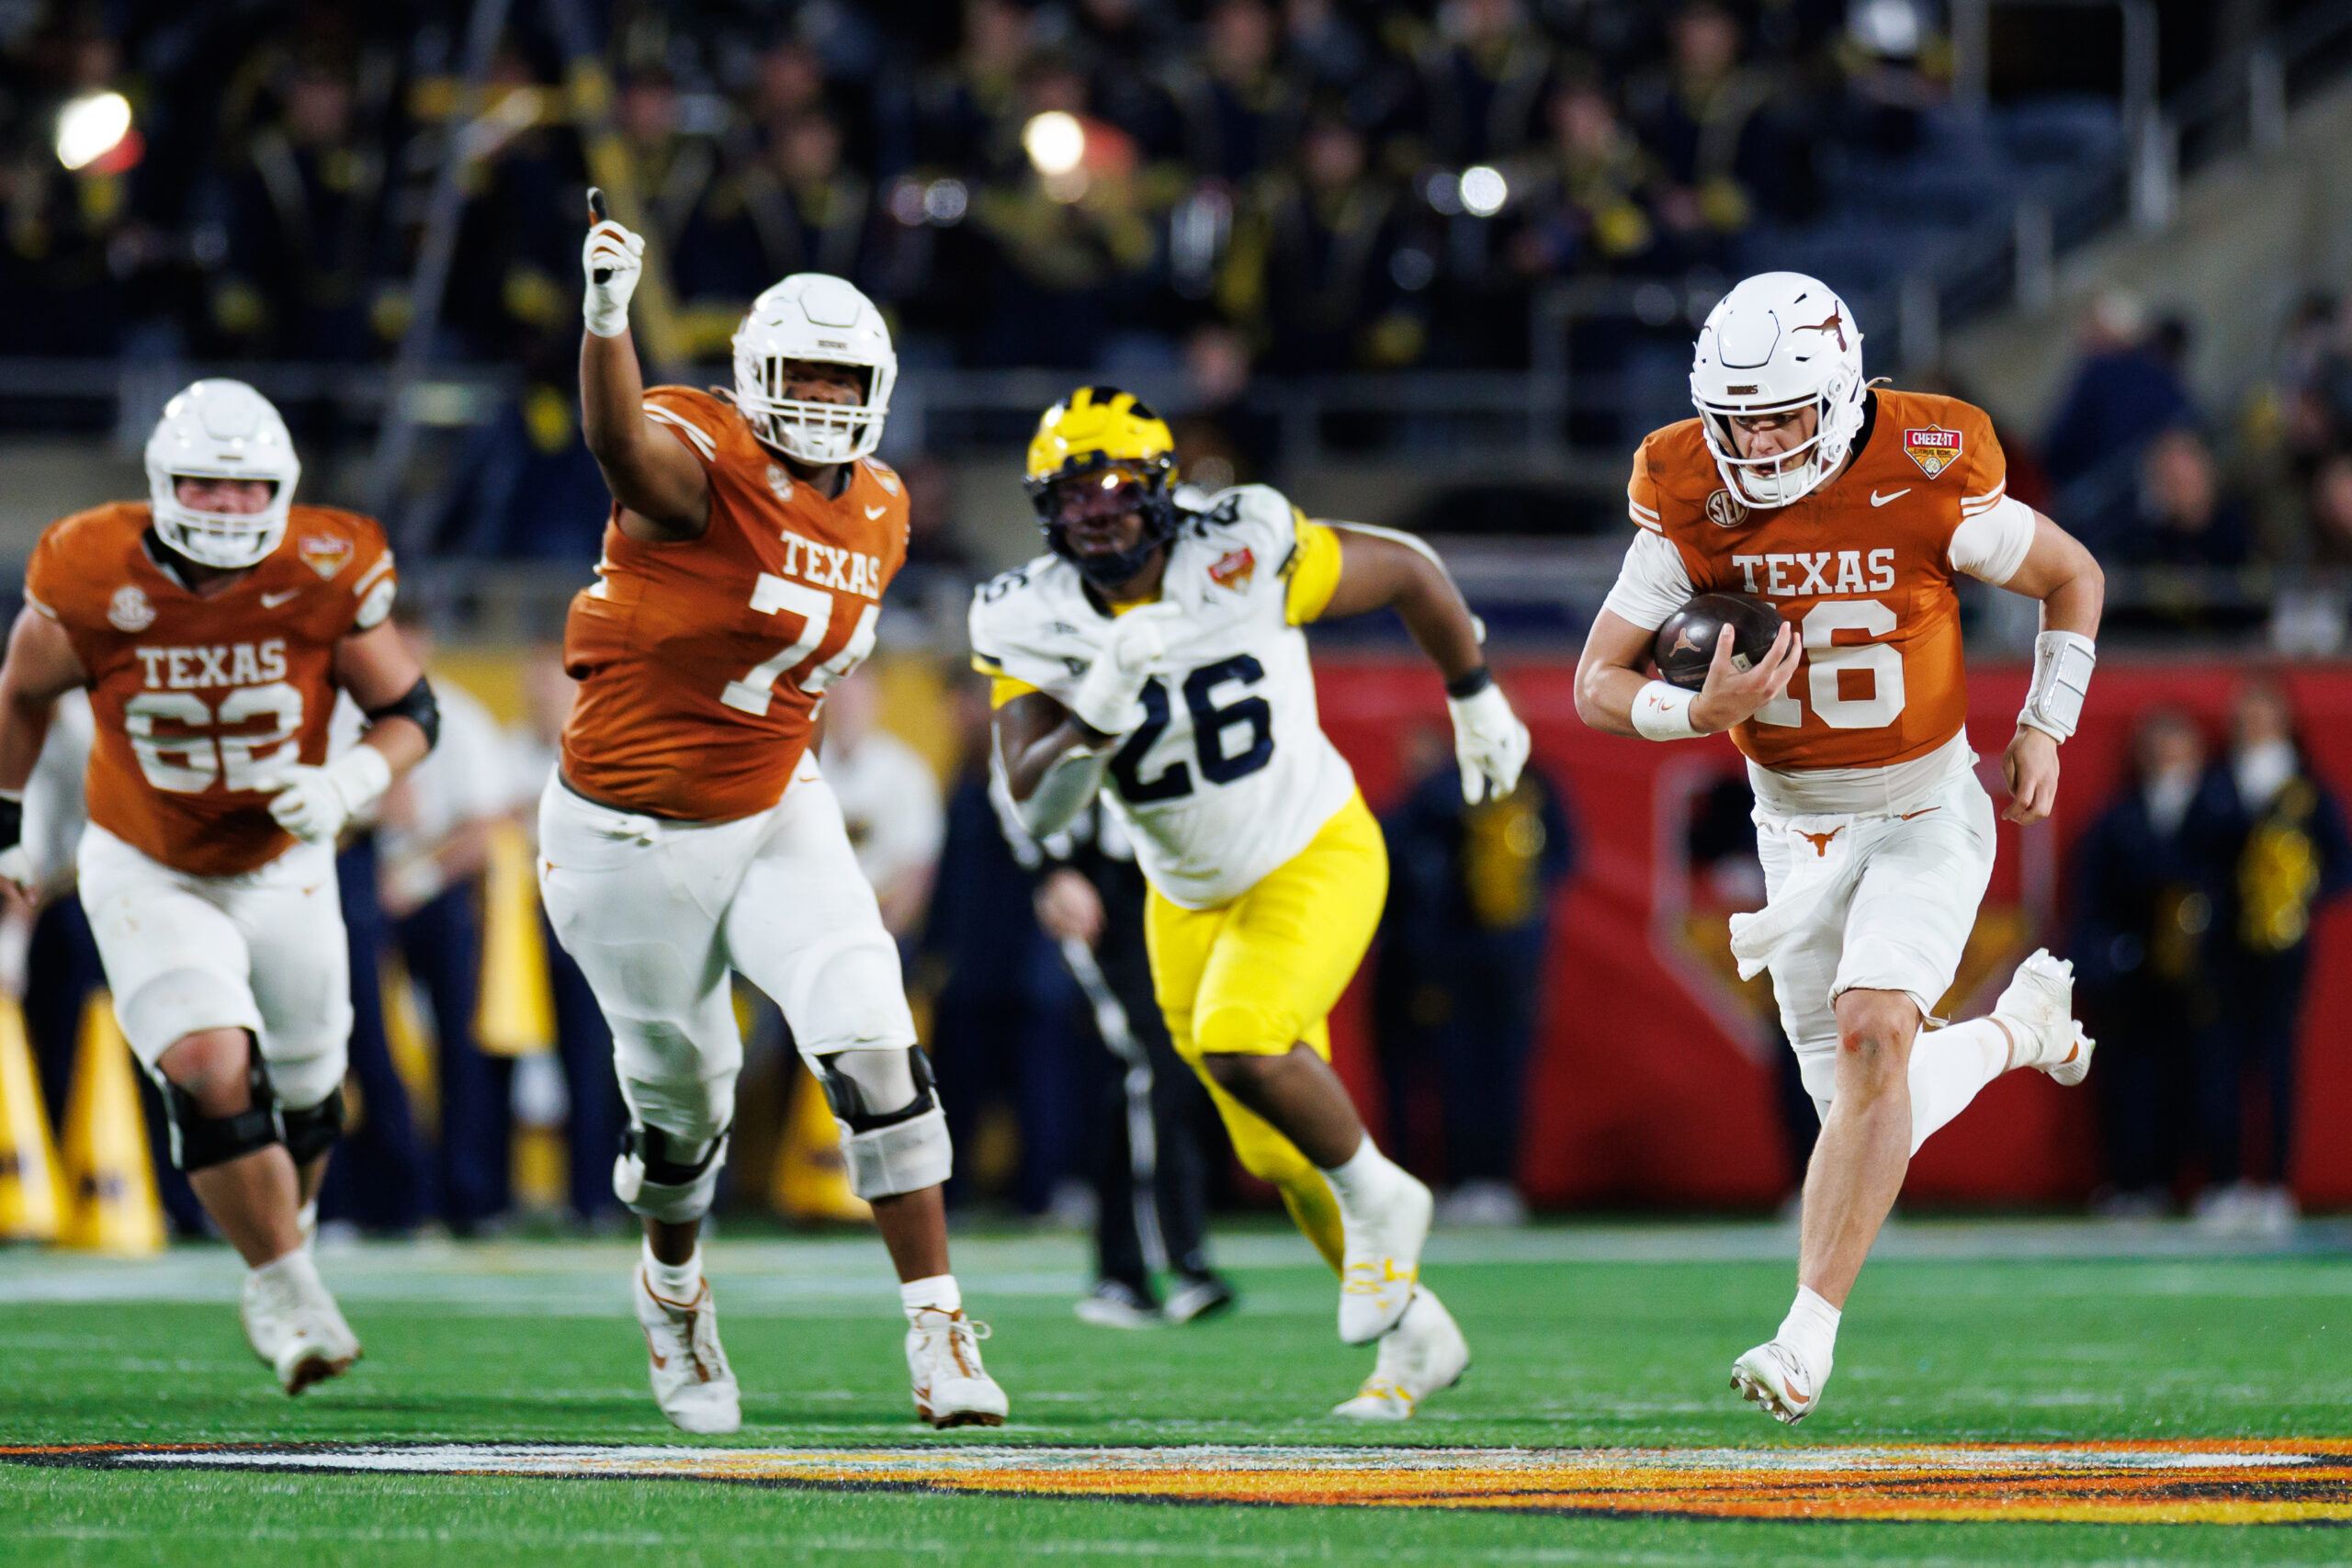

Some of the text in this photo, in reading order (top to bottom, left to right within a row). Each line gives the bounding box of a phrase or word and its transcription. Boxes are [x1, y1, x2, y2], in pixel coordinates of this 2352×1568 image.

[780, 529, 880, 600] TEXAS
[1732, 548, 1895, 596] TEXAS
[135, 637, 288, 688] TEXAS
[124, 682, 304, 795] 62
[1109, 653, 1275, 805] 26
